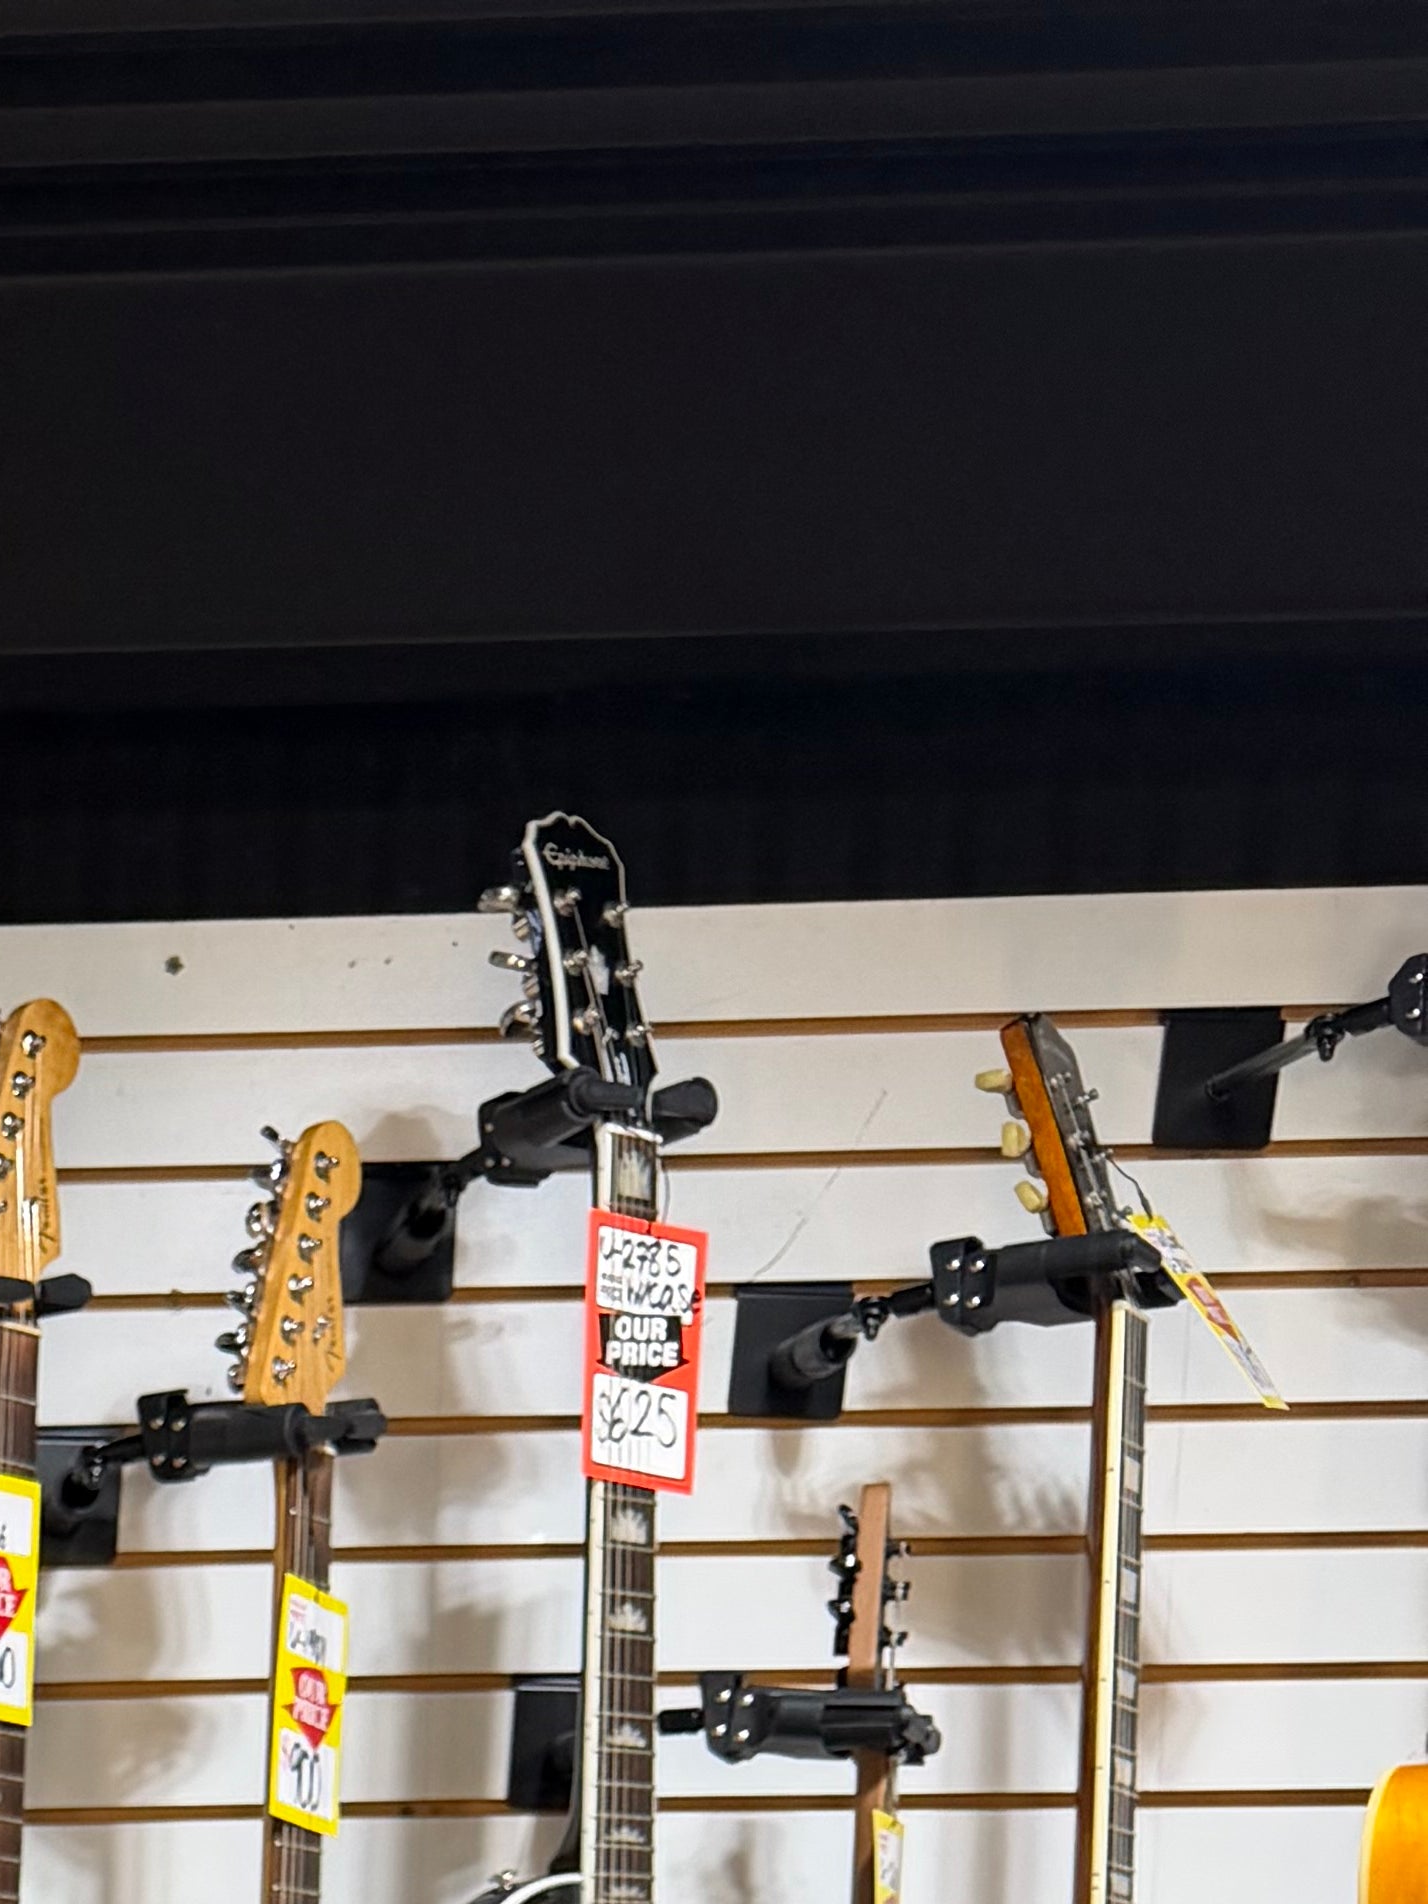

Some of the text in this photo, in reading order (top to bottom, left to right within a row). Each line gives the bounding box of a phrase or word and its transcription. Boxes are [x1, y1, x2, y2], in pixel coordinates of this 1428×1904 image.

[542, 842, 612, 872] Epiphone
[614, 1315, 668, 1342] OUR
[605, 1340, 680, 1368] PRICE
[598, 1387, 678, 1448] $625
